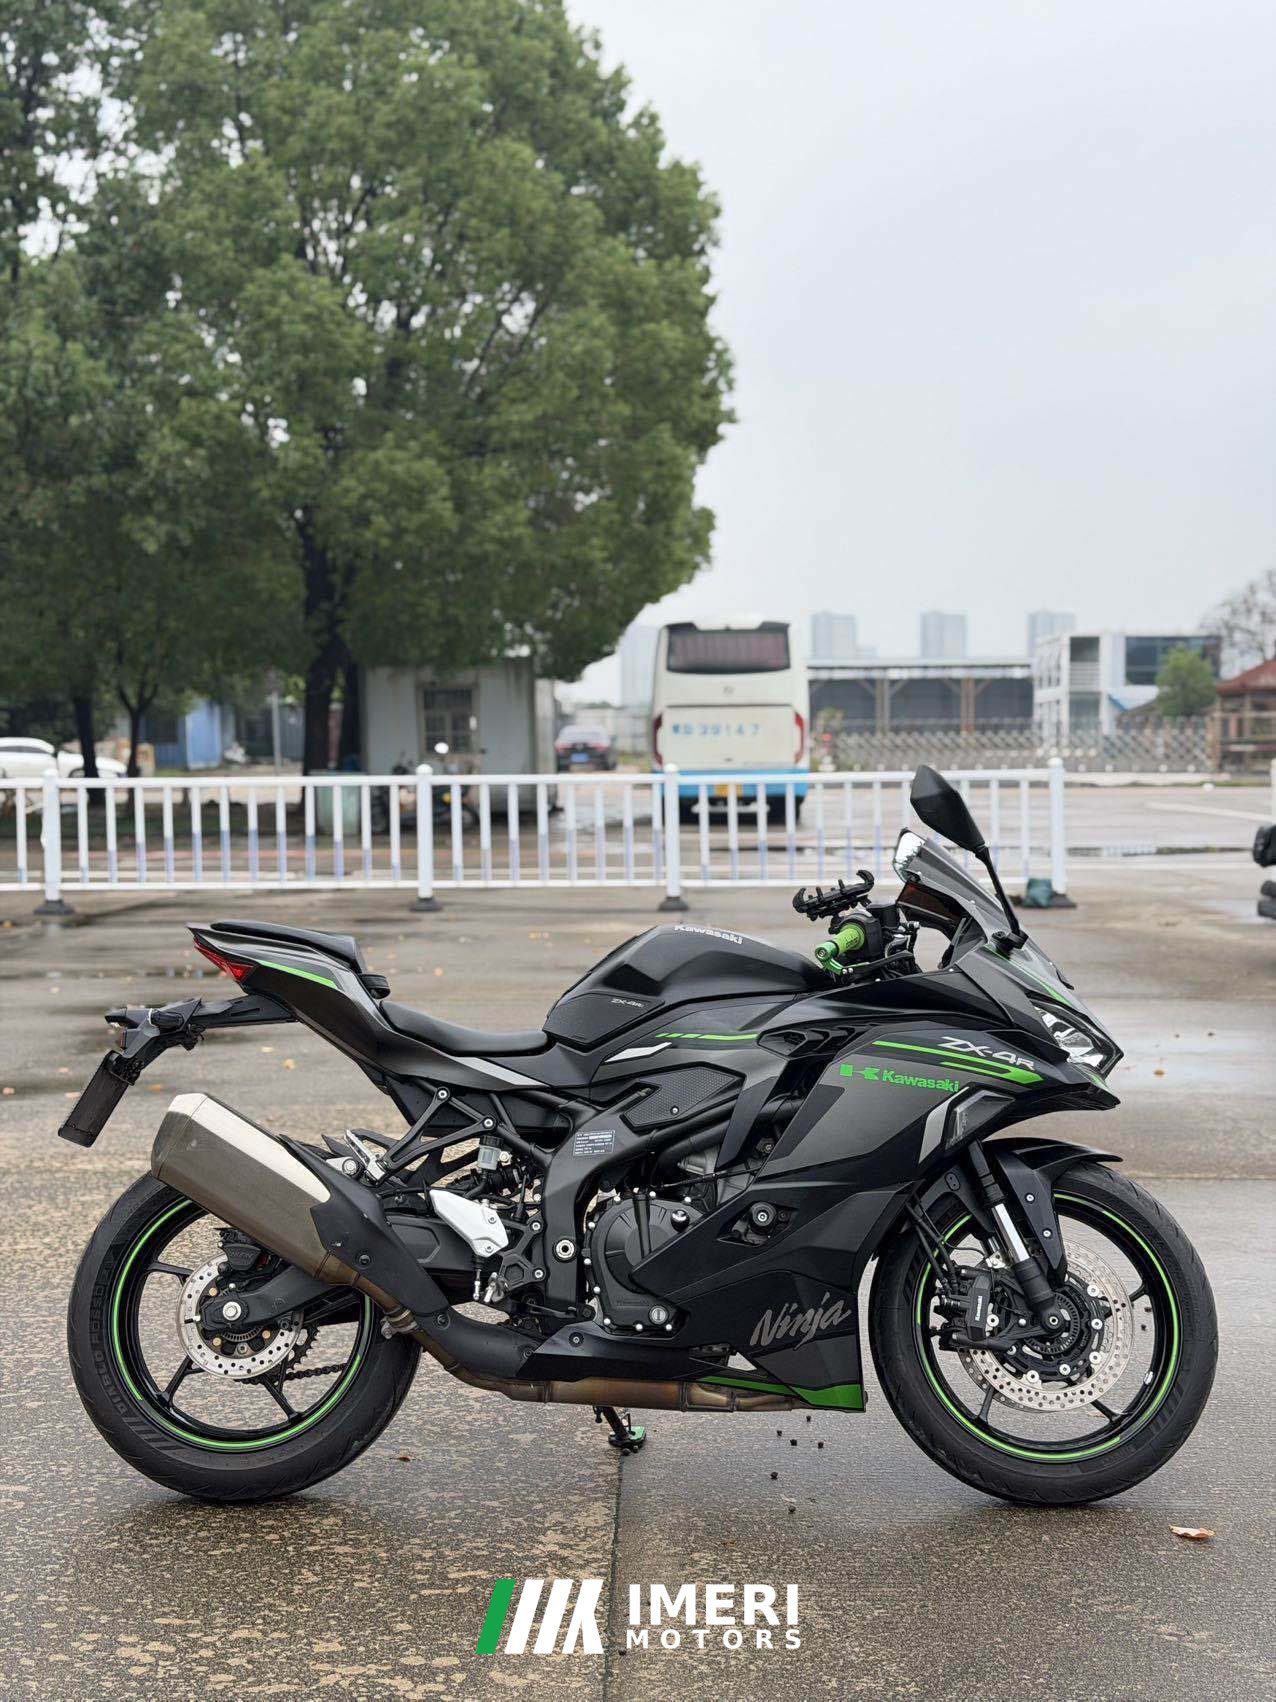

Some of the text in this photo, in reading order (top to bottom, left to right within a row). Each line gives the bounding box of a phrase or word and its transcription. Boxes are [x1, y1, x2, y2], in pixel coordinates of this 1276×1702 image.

[674, 924, 743, 945] Kawasaki
[937, 1036, 1035, 1071] ZX-4R
[882, 1069, 960, 1092] Kawasaki
[749, 1291, 852, 1351] Ninja
